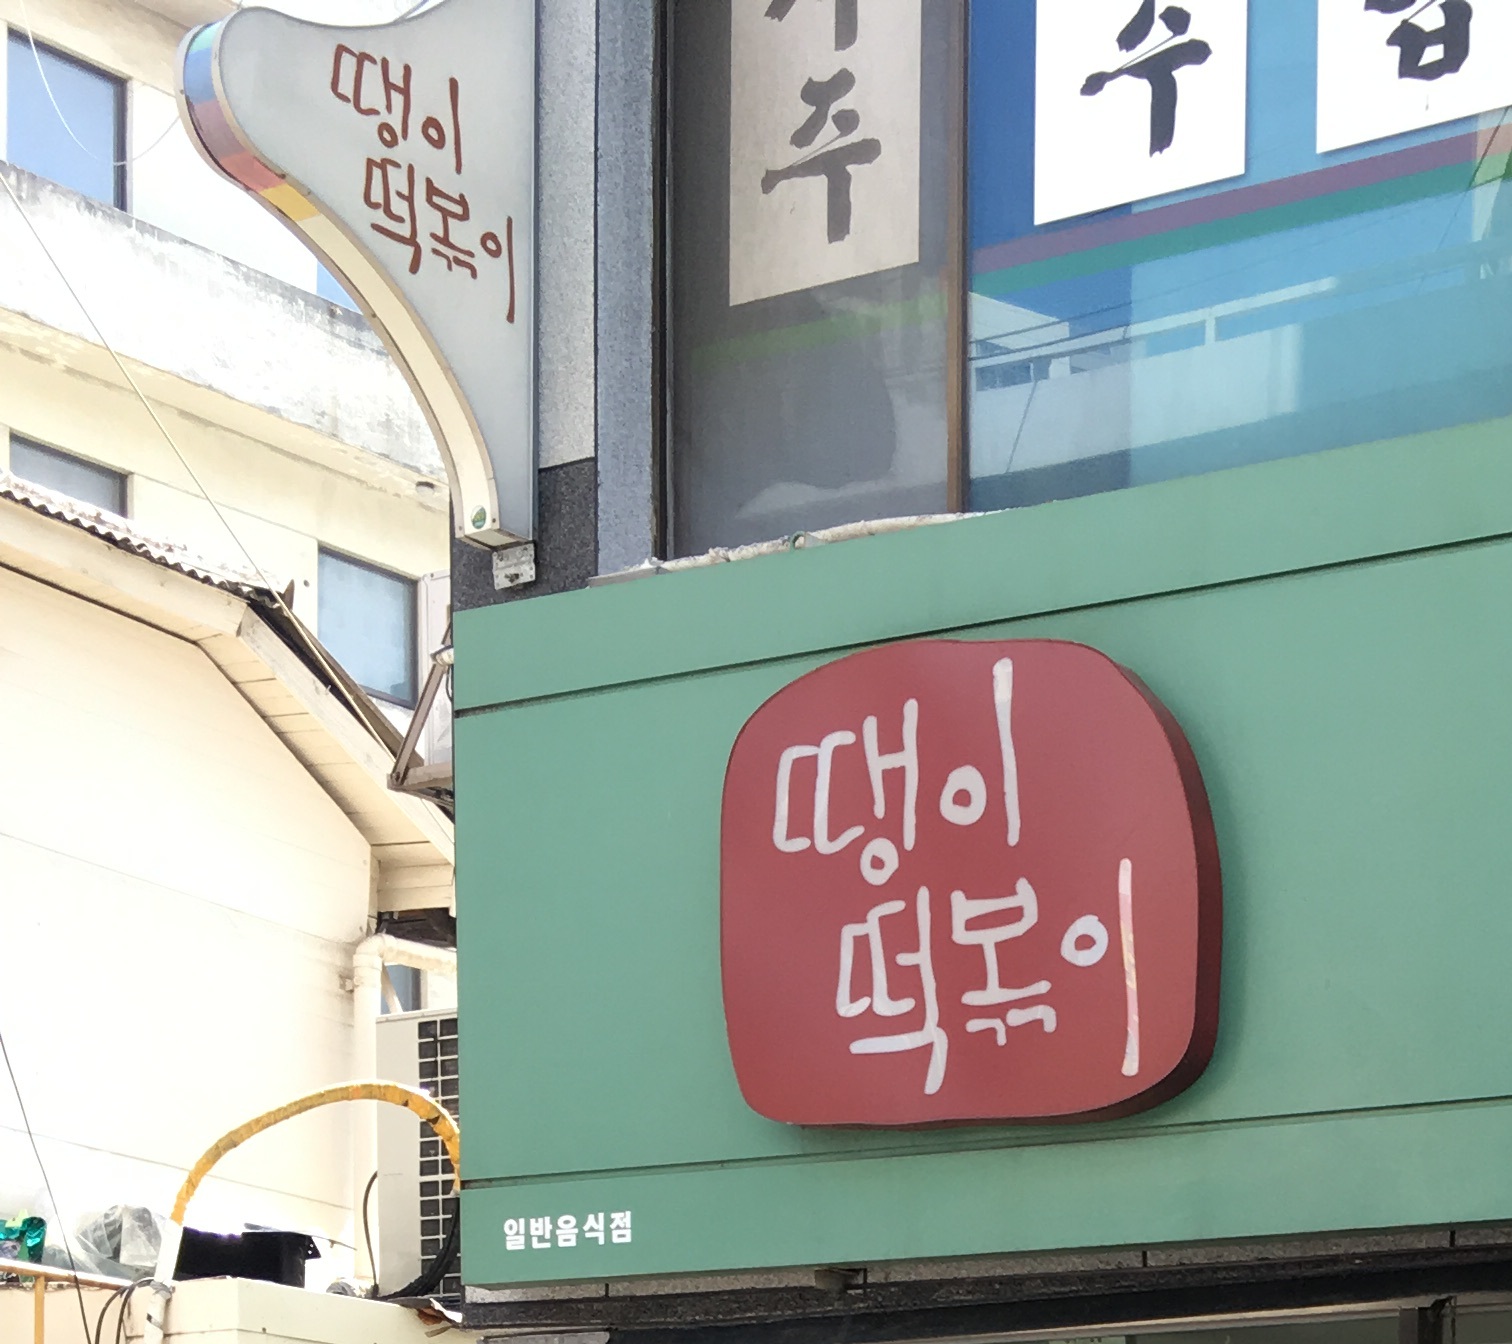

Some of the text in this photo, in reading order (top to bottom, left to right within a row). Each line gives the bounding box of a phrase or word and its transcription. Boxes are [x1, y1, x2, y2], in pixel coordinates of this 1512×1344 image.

[331, 43, 462, 175] 땡이
[363, 156, 517, 324] 떡볶이
[772, 657, 1021, 886] 땡이
[835, 857, 1140, 1095] 떡볶이
[502, 1210, 633, 1252] 일반음식점
